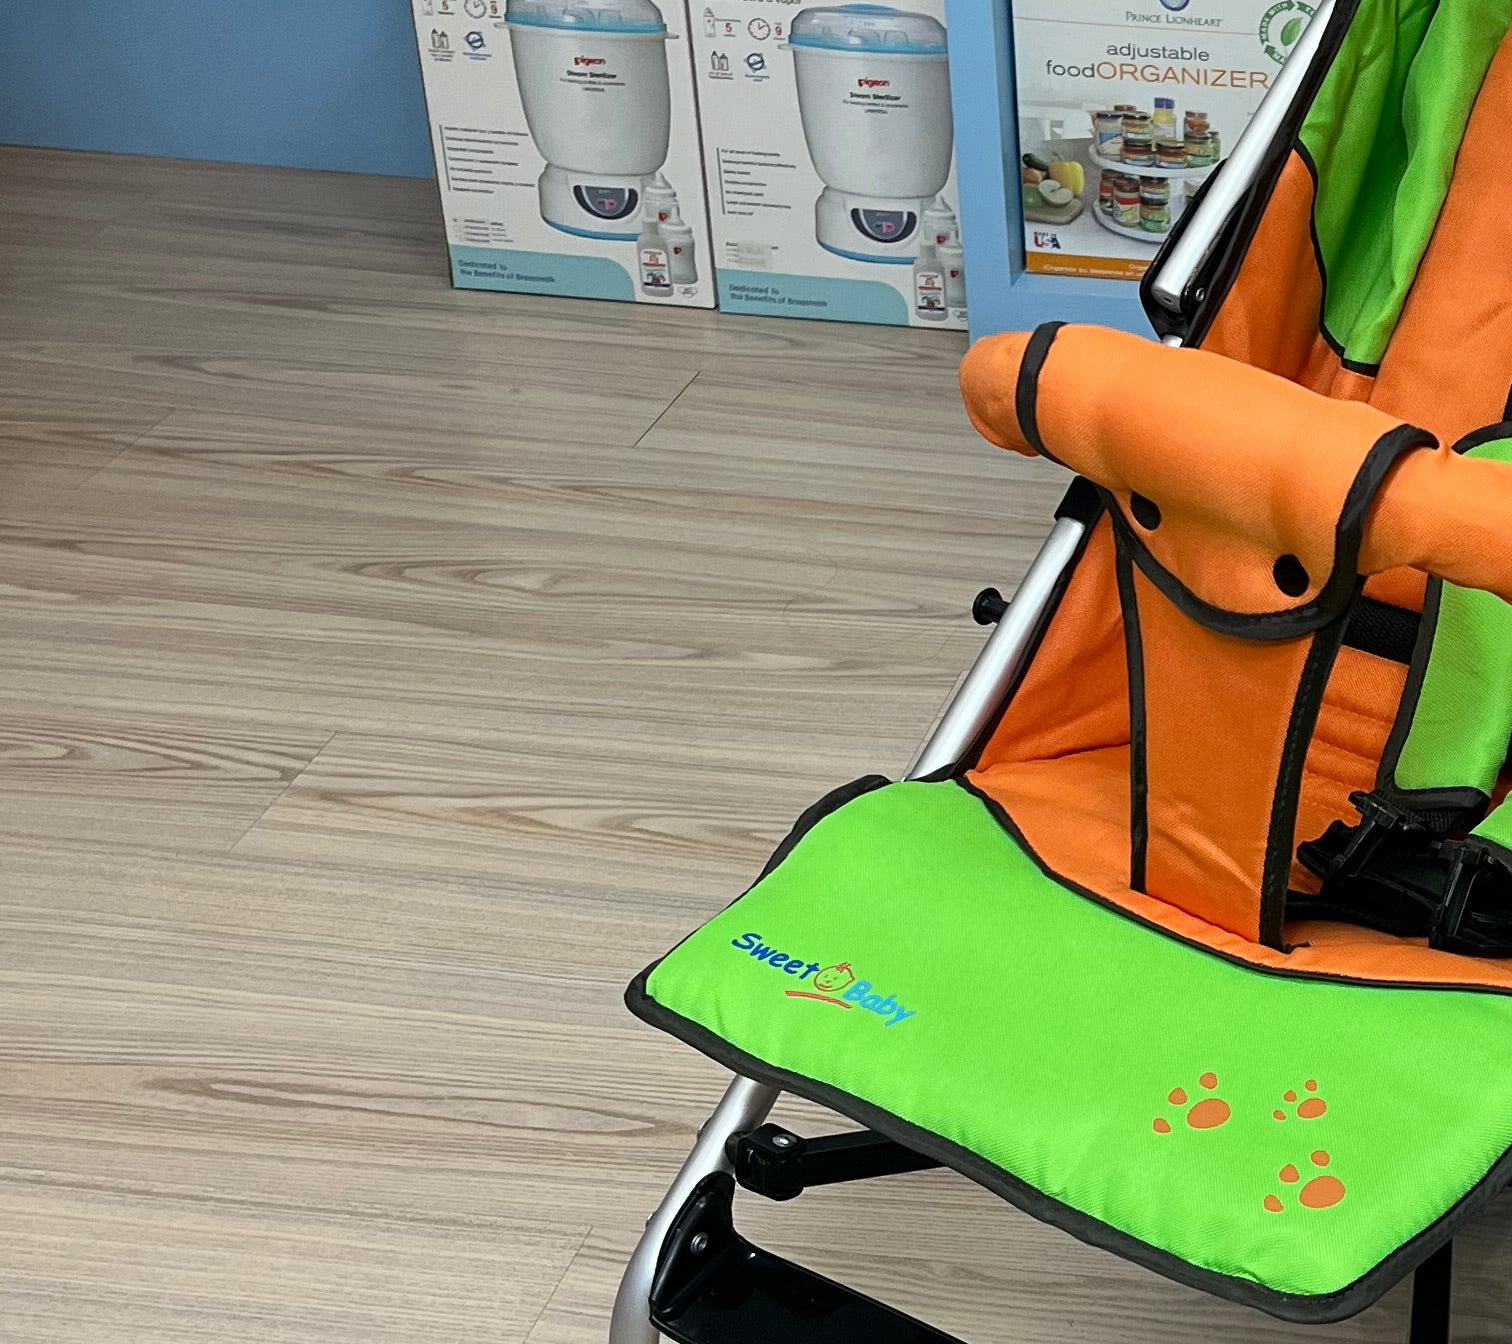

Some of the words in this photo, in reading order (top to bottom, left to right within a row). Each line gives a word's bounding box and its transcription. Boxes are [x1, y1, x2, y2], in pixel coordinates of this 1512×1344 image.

[1125, 11, 1161, 24] PRINCE
[1165, 13, 1224, 28] LIONHEART
[1106, 42, 1210, 62] adjustable
[573, 55, 606, 67] pigeon
[857, 76, 890, 88] pigeon
[731, 932, 820, 980] Sweet
[842, 980, 916, 1027] Baby
